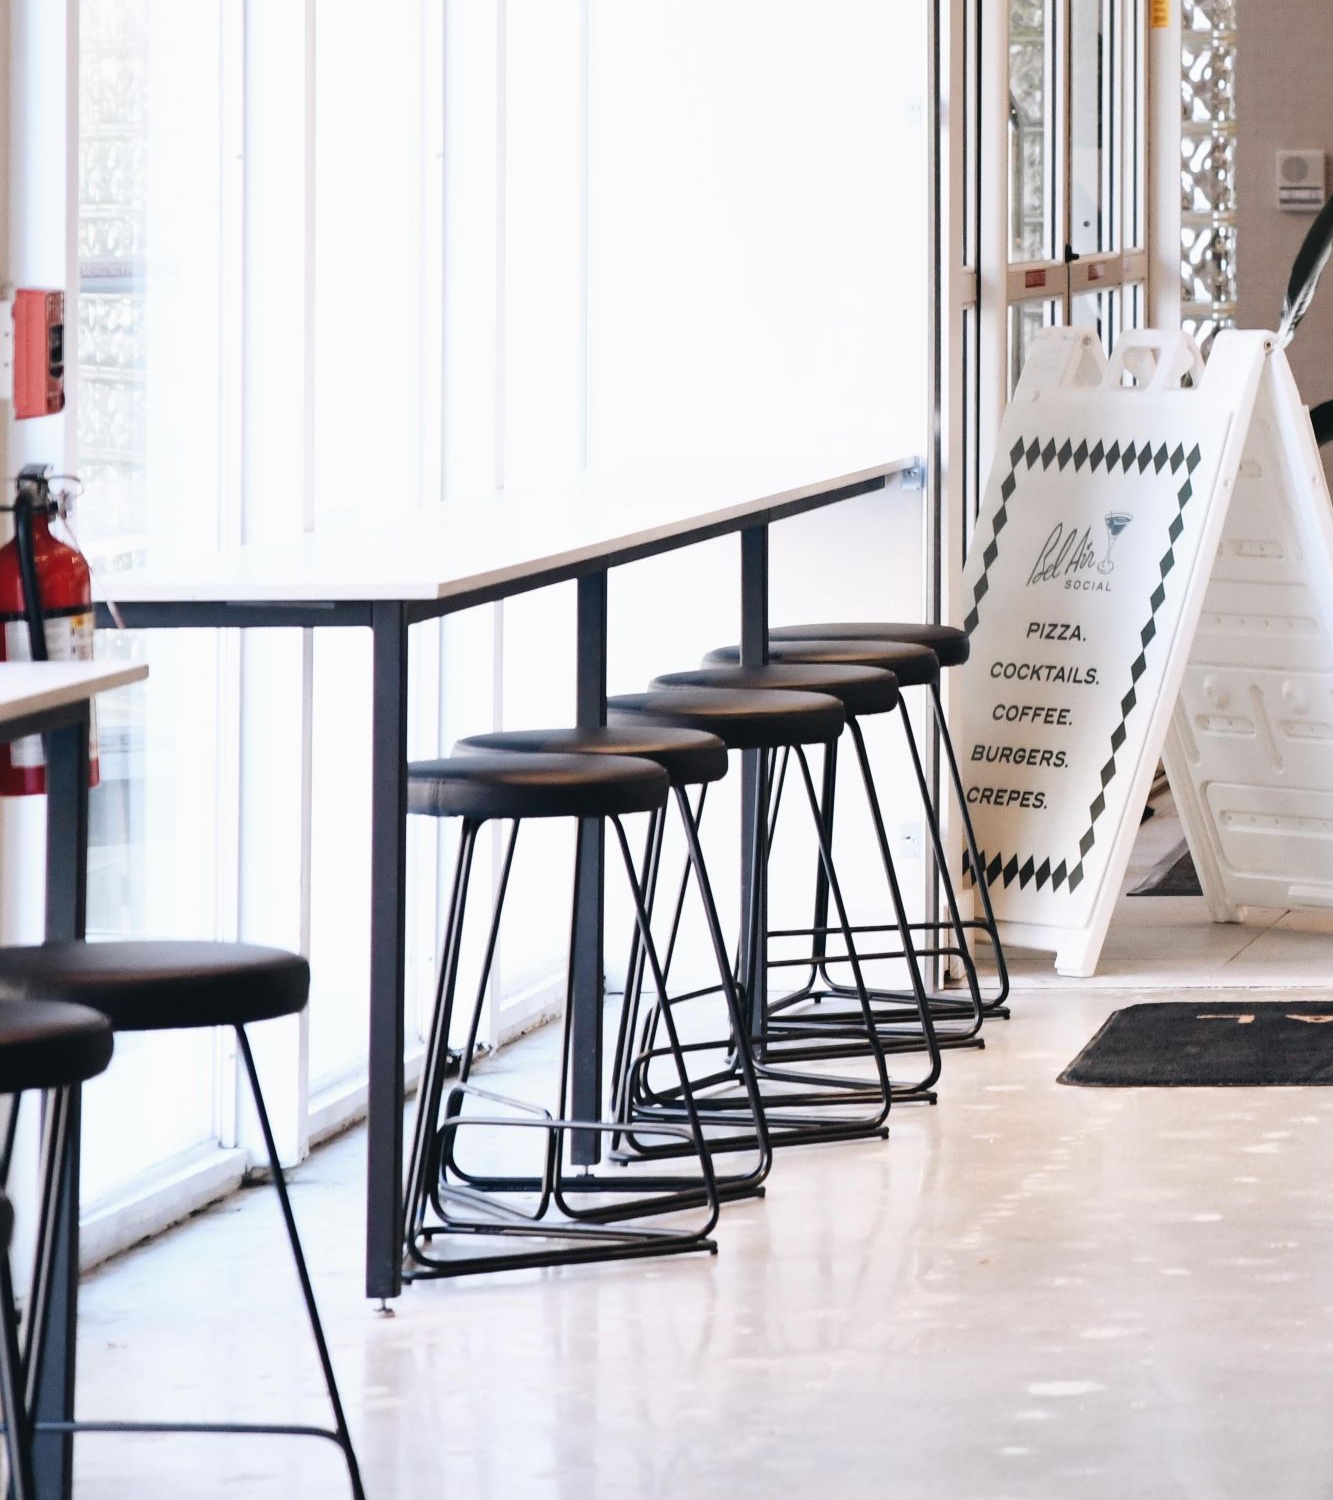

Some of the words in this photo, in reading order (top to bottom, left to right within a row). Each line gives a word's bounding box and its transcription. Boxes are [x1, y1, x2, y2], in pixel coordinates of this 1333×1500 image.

[1026, 522, 1077, 587] Bel
[1064, 525, 1097, 575] Air
[1064, 580, 1111, 592] SOCIAL
[1026, 622, 1087, 642] PIZZA.
[990, 662, 1100, 685] COCKTAILS.
[992, 704, 1073, 726] COFFEE.
[971, 744, 1069, 768] BURGERS.
[966, 786, 1048, 809] CREPES.
